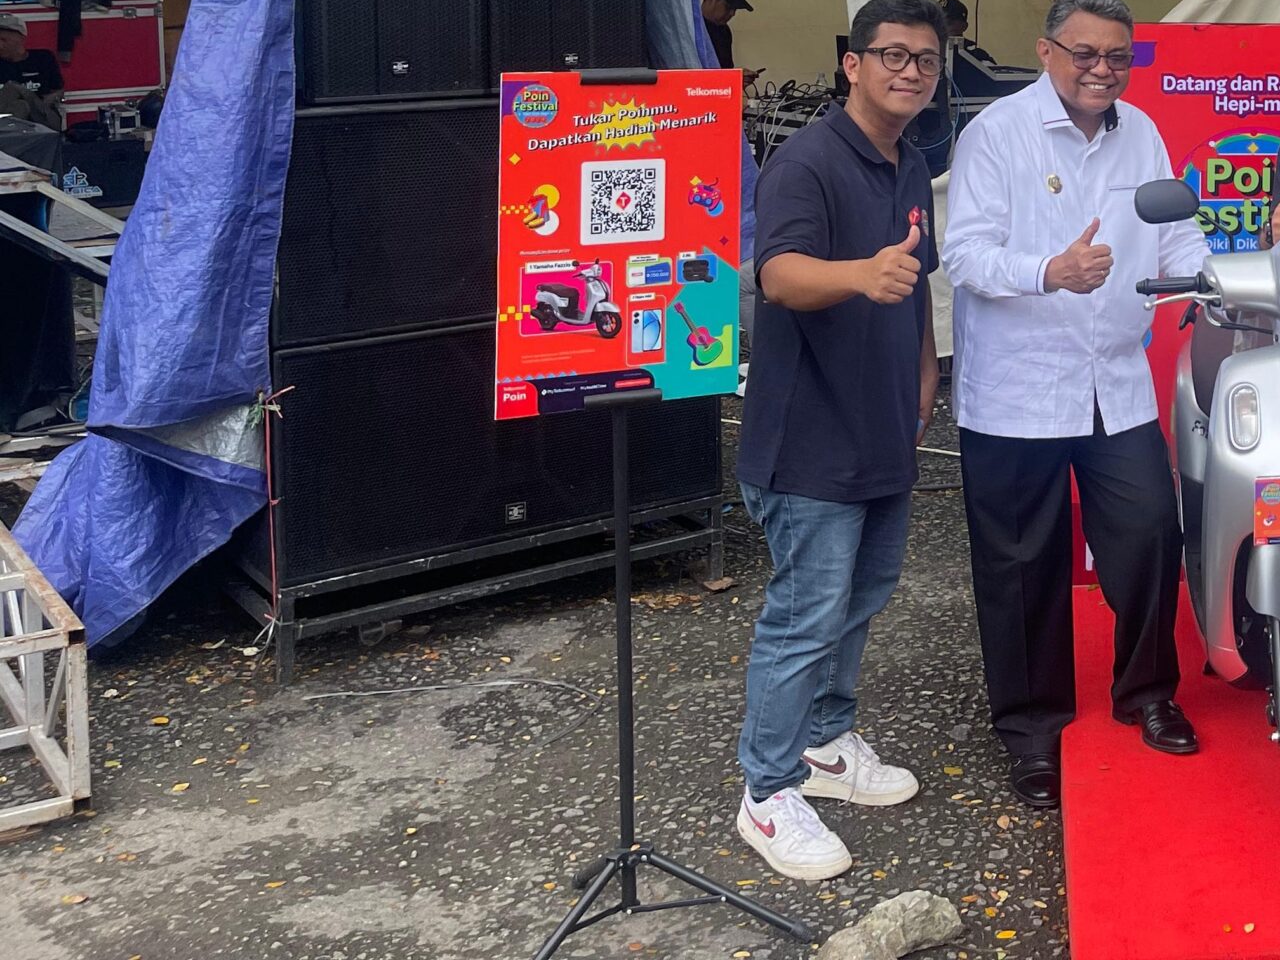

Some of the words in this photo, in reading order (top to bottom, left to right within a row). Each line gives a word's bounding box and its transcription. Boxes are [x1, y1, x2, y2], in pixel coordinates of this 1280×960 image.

[685, 87, 732, 98] Telkomsel
[1162, 75, 1228, 96] Datang
[1230, 74, 1263, 93] dan
[523, 91, 549, 102] Poin
[513, 101, 558, 112] Festival
[572, 110, 614, 127] Tukar
[618, 103, 678, 120] Poinmu,
[527, 129, 602, 152] Dapatkan
[604, 122, 656, 140] Hadiah
[659, 110, 718, 132] Menarik
[1206, 157, 1273, 193] Poi
[1194, 196, 1271, 233] esti
[1236, 238, 1258, 251] Dik
[502, 392, 527, 403] Poin
